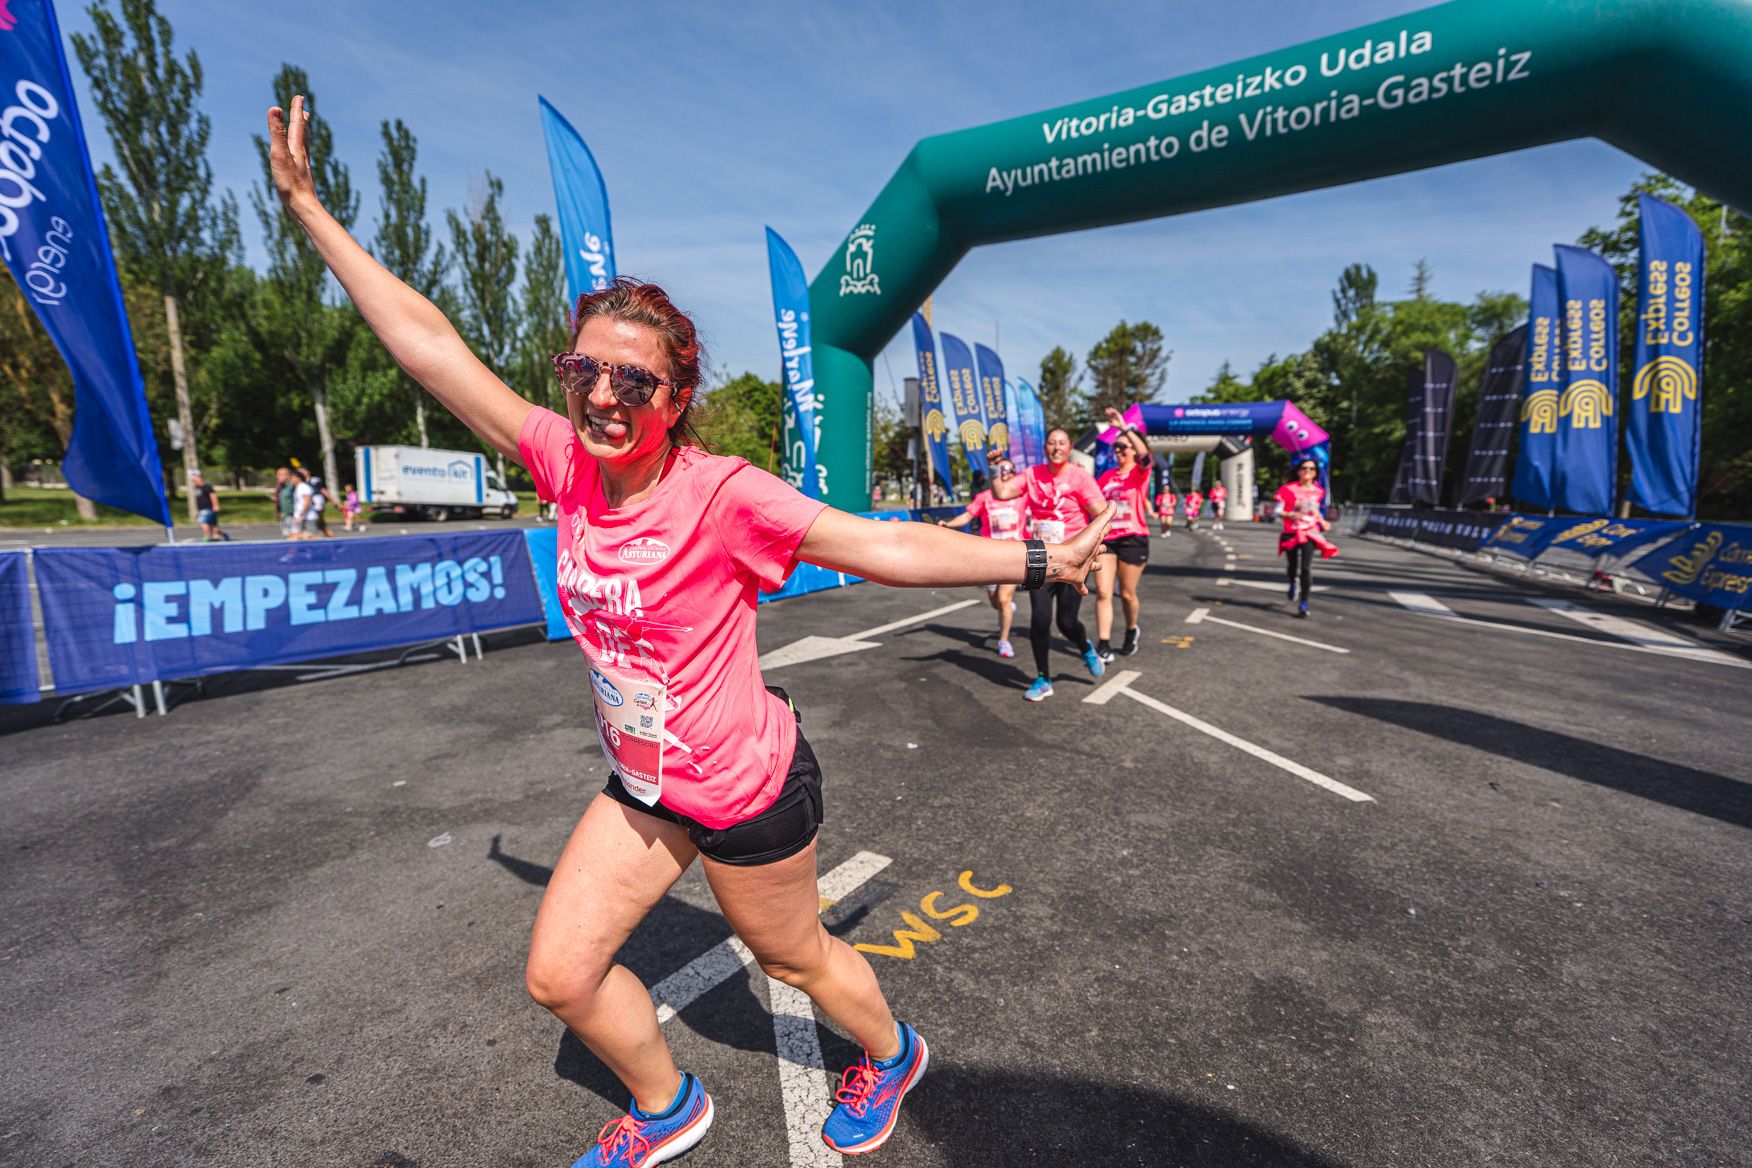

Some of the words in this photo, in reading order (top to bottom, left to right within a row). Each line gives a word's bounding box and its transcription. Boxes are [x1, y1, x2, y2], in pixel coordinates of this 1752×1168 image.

[984, 130, 1181, 198] Ayuntamiento
[1188, 119, 1229, 153] de
[1239, 47, 1533, 142] Vitoria-Gasteiz
[1042, 63, 1307, 145] Vitoria-Gasteizko
[1320, 29, 1433, 78] Udala
[453, 466, 469, 479] kit
[621, 547, 667, 560] ASTURIANA
[112, 555, 506, 645] ¡EMPEZAMOS!
[852, 869, 1013, 960] WSC
